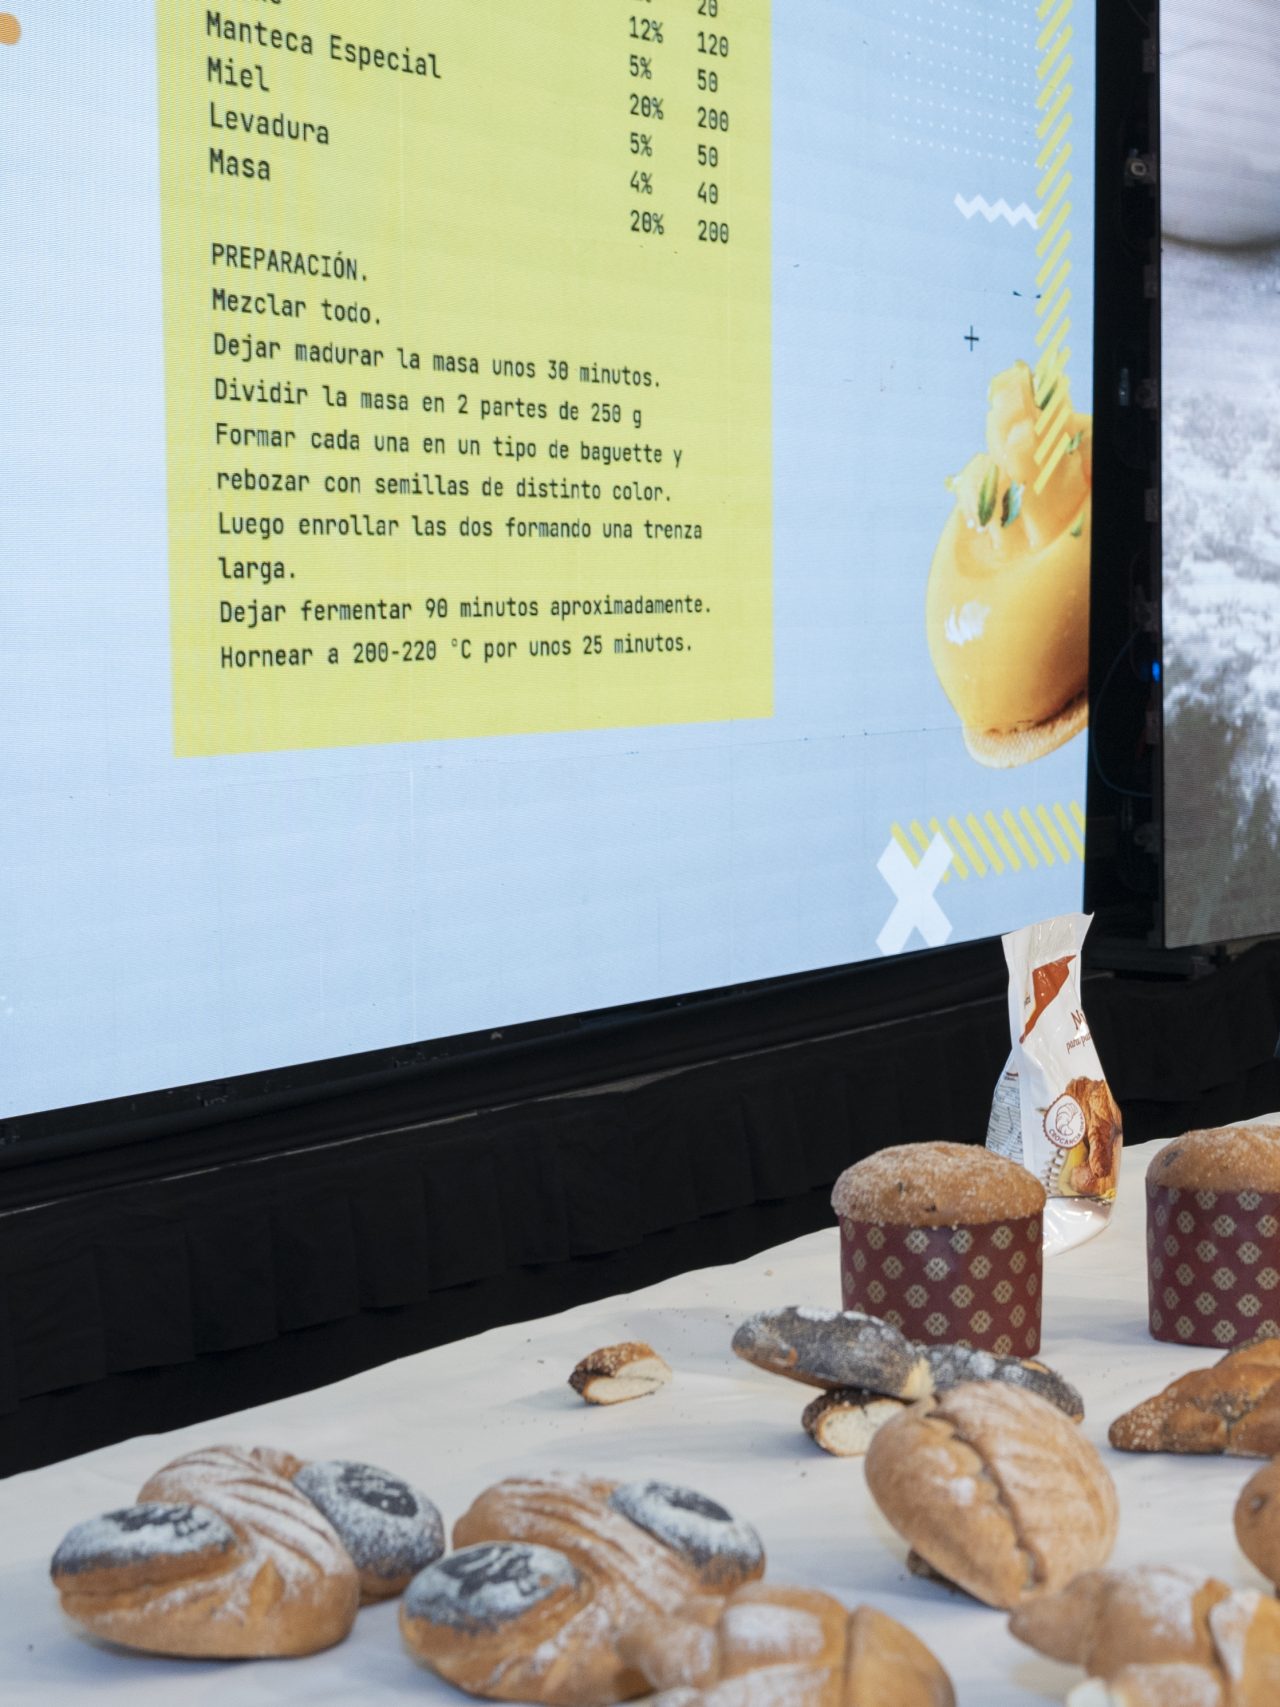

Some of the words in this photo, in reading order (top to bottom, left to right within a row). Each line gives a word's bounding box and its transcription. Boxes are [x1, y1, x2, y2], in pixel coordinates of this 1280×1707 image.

[205, 9, 313, 55] Manteca
[330, 34, 442, 79] Especial
[629, 15, 664, 44] 12%
[697, 31, 729, 58] 120
[207, 55, 270, 93] Miel
[629, 53, 652, 80] 5%
[697, 68, 718, 93] 50
[210, 101, 329, 145] Levadura
[629, 92, 664, 121] 20%
[697, 105, 729, 133] 200
[209, 147, 271, 181] Masa
[630, 131, 653, 158] 5%
[697, 143, 719, 168] 50
[629, 170, 653, 195] 4%
[697, 181, 719, 205] 40
[630, 209, 665, 236] 20%
[697, 219, 729, 245] 200
[212, 242, 367, 282] PREPARACIÓN.
[212, 287, 307, 318] Mezclar
[320, 299, 380, 325] todo.
[213, 331, 281, 363] Dejar
[294, 342, 384, 367] madurar
[396, 347, 421, 370] la
[432, 354, 479, 375] masa
[492, 359, 536, 379] unos
[547, 359, 569, 381] 30
[579, 366, 660, 388] minutos.
[214, 377, 309, 405] Dividir
[321, 384, 348, 408] la
[360, 391, 409, 411] masa
[422, 395, 445, 413] en
[457, 393, 469, 415] 2
[480, 397, 548, 421] partes
[558, 400, 579, 421] de
[591, 402, 622, 424] 250
[632, 409, 642, 429] g
[215, 422, 296, 448] Formar
[311, 428, 360, 451] cada
[374, 435, 410, 453] una
[423, 437, 446, 454] en
[458, 439, 481, 456] un
[492, 435, 537, 462] tipo
[548, 439, 569, 460] de
[580, 440, 663, 466] baguette
[673, 449, 683, 468] y
[217, 467, 310, 492] rebozar
[324, 475, 361, 494] con
[375, 472, 470, 497] semillas
[481, 476, 504, 497] de
[516, 476, 601, 500] distinto
[612, 481, 671, 502] color.
[218, 511, 285, 541] Luego
[298, 513, 400, 537] enrollar
[411, 514, 447, 537] las
[459, 516, 493, 537] dos
[505, 516, 592, 538] formando
[602, 523, 633, 539] una
[643, 519, 703, 540] trenza
[217, 556, 295, 586] larga.
[220, 598, 287, 629] Dejar
[300, 599, 413, 622] fermentar
[425, 597, 448, 619] 90
[460, 595, 539, 618] minutos
[550, 594, 711, 622] aproximadamente.
[220, 646, 313, 669] Hornear
[327, 647, 339, 665] a
[353, 639, 437, 664] 200-220
[451, 638, 472, 660] °C
[484, 641, 518, 664] por
[529, 639, 572, 657] unos
[582, 634, 603, 655] 25
[614, 634, 692, 654] minutos.
